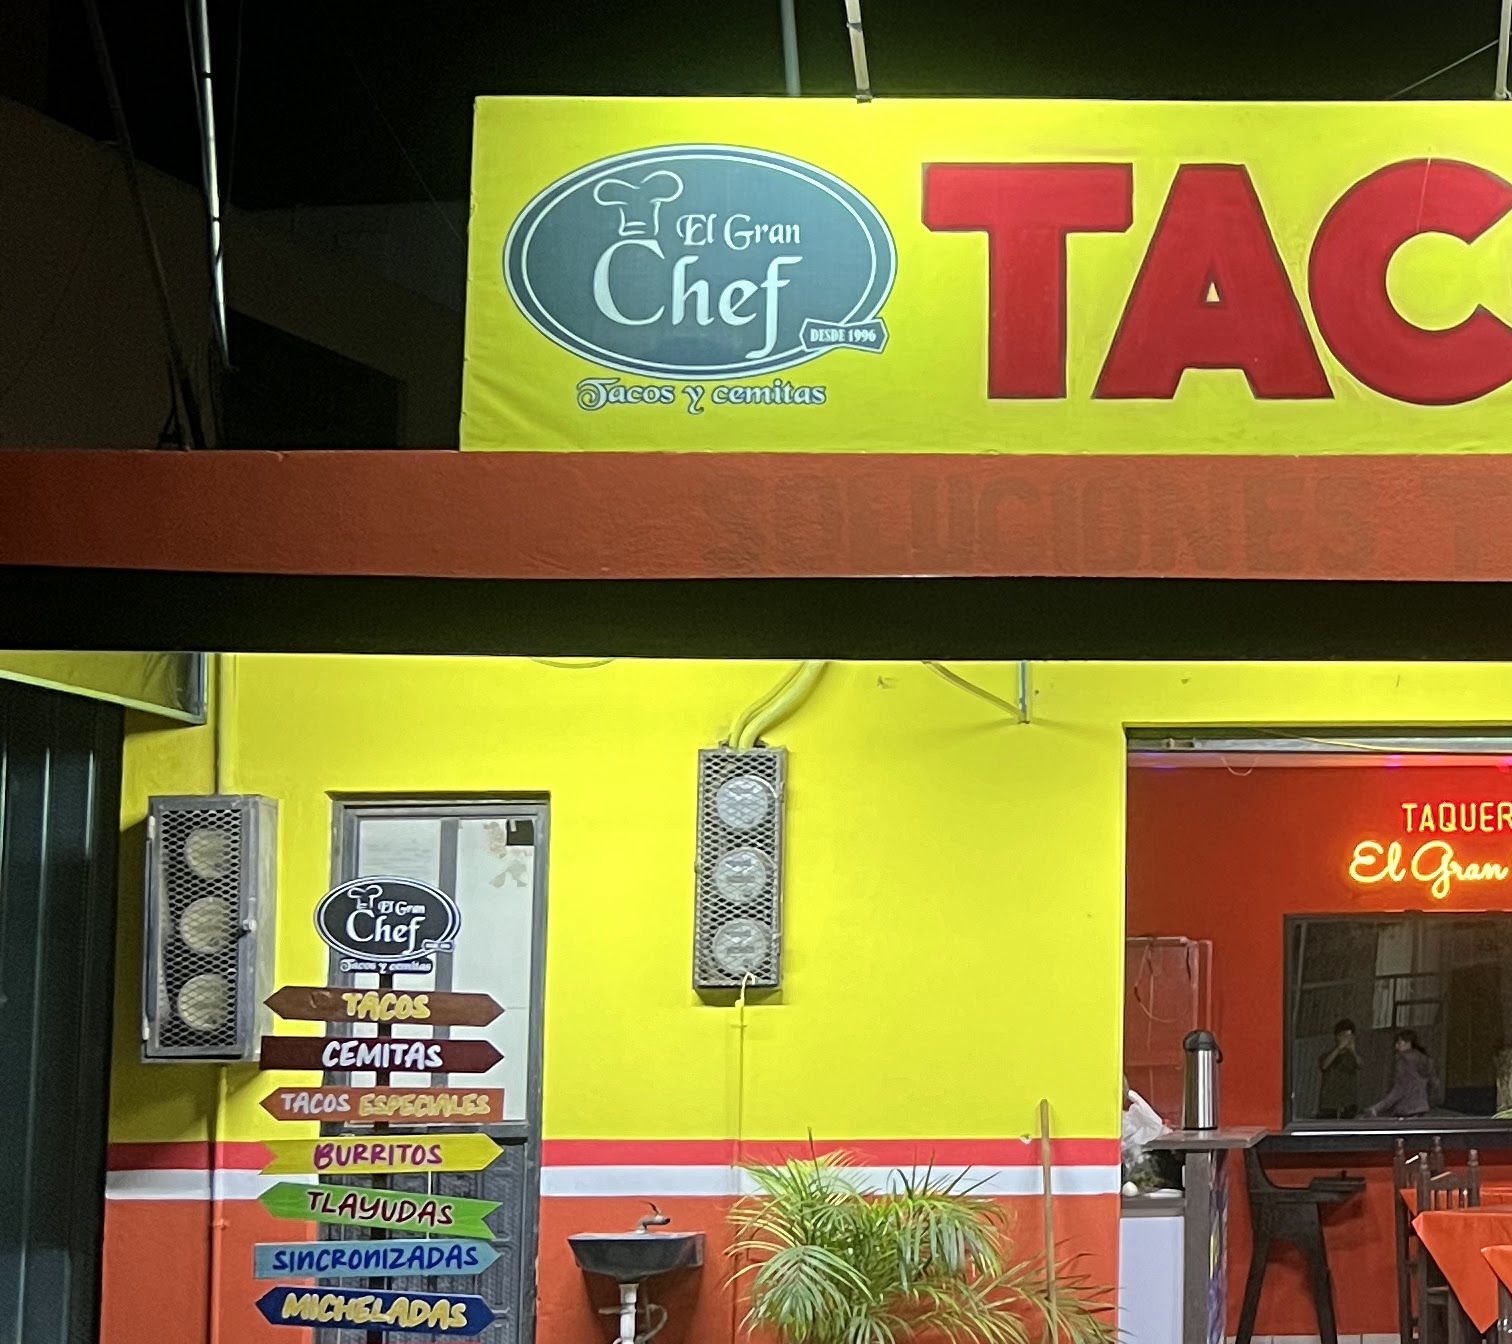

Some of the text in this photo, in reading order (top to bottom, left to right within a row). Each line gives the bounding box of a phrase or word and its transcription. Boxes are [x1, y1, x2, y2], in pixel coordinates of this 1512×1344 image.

[676, 213, 801, 250] El Gran
[593, 239, 803, 359] Chef
[810, 327, 877, 342] DESDE 1996
[577, 377, 826, 414] Tacos y cemitas
[1349, 840, 1406, 884] El
[1410, 839, 1509, 900] Gran
[346, 909, 427, 955] Chef
[342, 991, 431, 1021] TACOS
[322, 1040, 443, 1070] CEMITAS
[280, 1091, 491, 1118] TACOS ESPECIALES
[313, 1143, 443, 1170] BURRITOS
[306, 1190, 453, 1227] TLAYUDAS
[272, 1243, 479, 1273] SINCRONIZADAS
[281, 1292, 468, 1331] MICHELADAS
